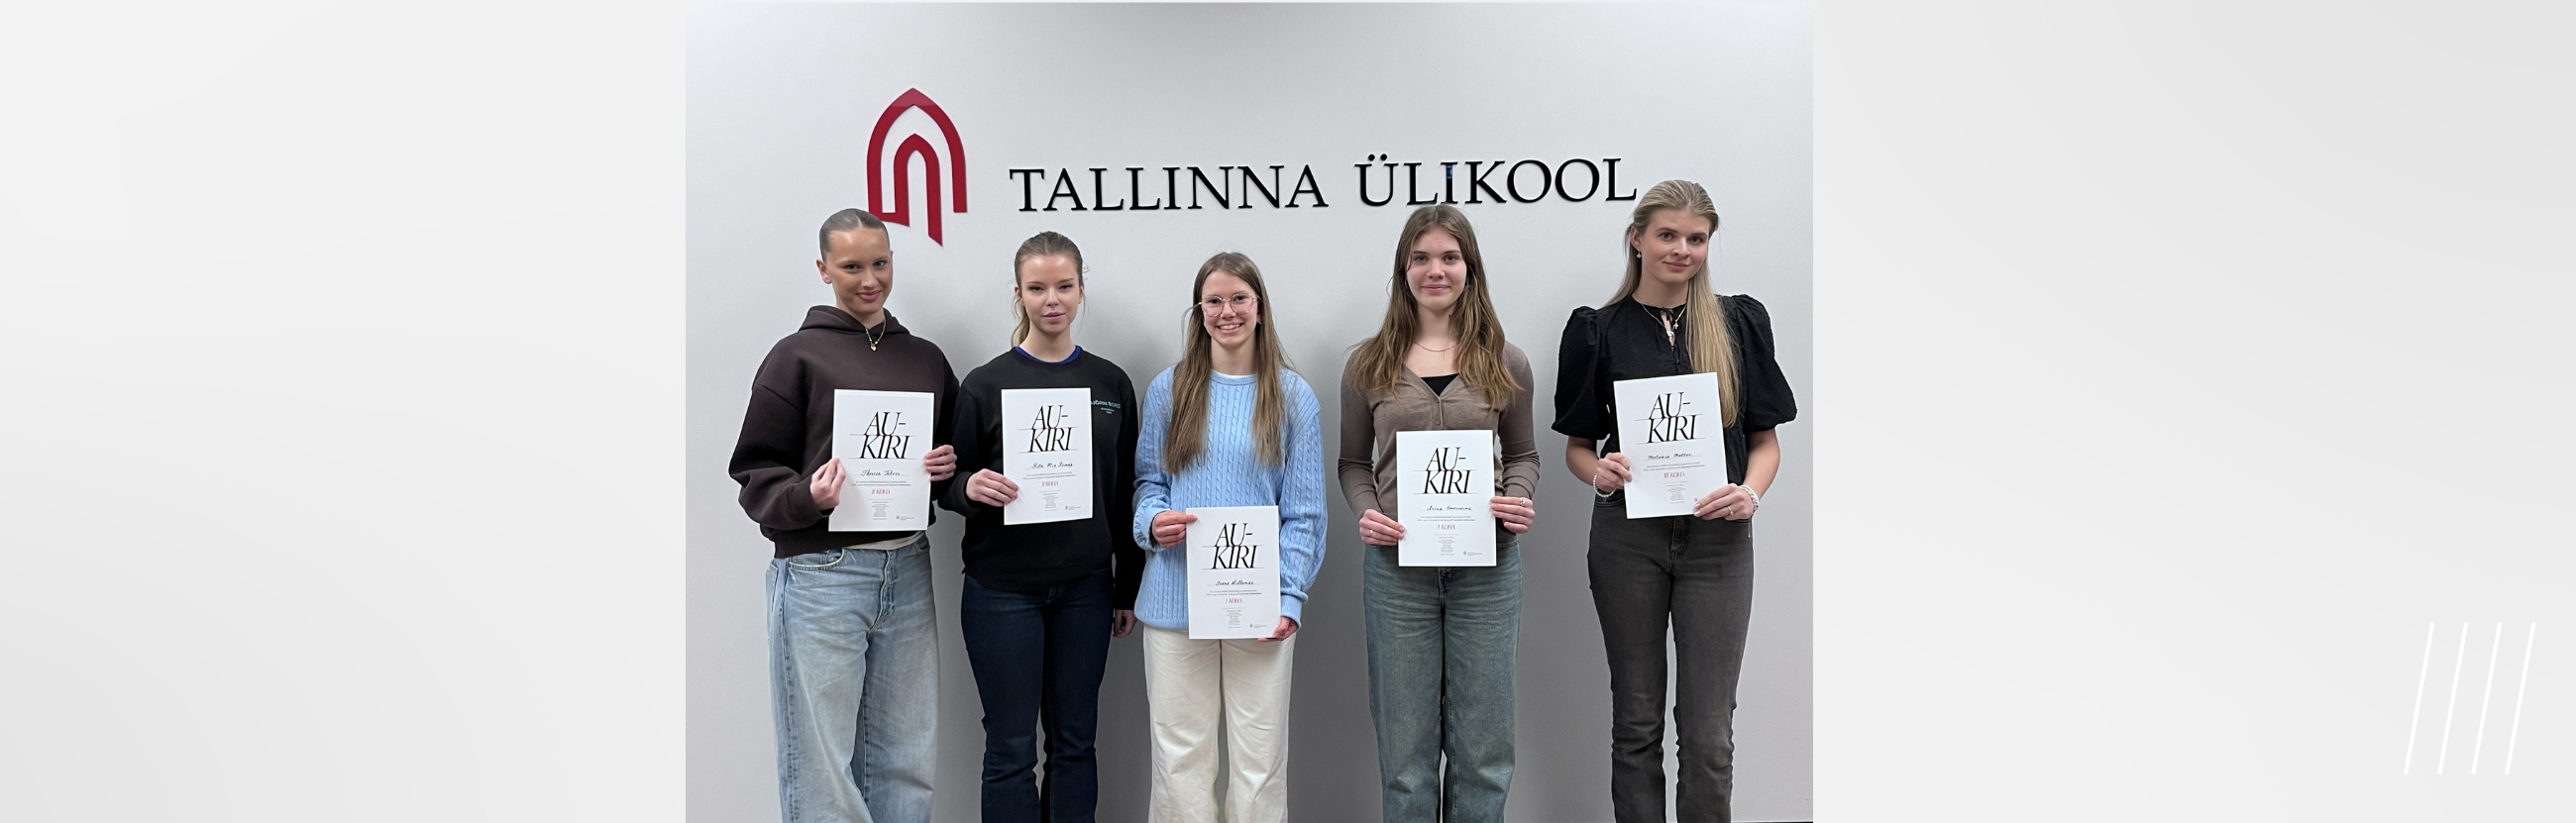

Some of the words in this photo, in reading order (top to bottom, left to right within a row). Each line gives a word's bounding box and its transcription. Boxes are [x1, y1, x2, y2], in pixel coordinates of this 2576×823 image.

[1010, 164, 1329, 211] TALLINNA
[1354, 154, 1637, 206] ÜLIKOOL
[1031, 405, 1068, 429] AU-
[1649, 391, 1690, 419] AU-
[864, 411, 906, 436] AU-
[1647, 415, 1696, 444] KIRI
[860, 435, 910, 459] KIRI
[1028, 427, 1073, 453] KIRI
[1426, 447, 1466, 471] AU-
[1424, 470, 1470, 494] KIRI
[1215, 523, 1252, 547] AU-
[1212, 546, 1256, 568] KIRI
